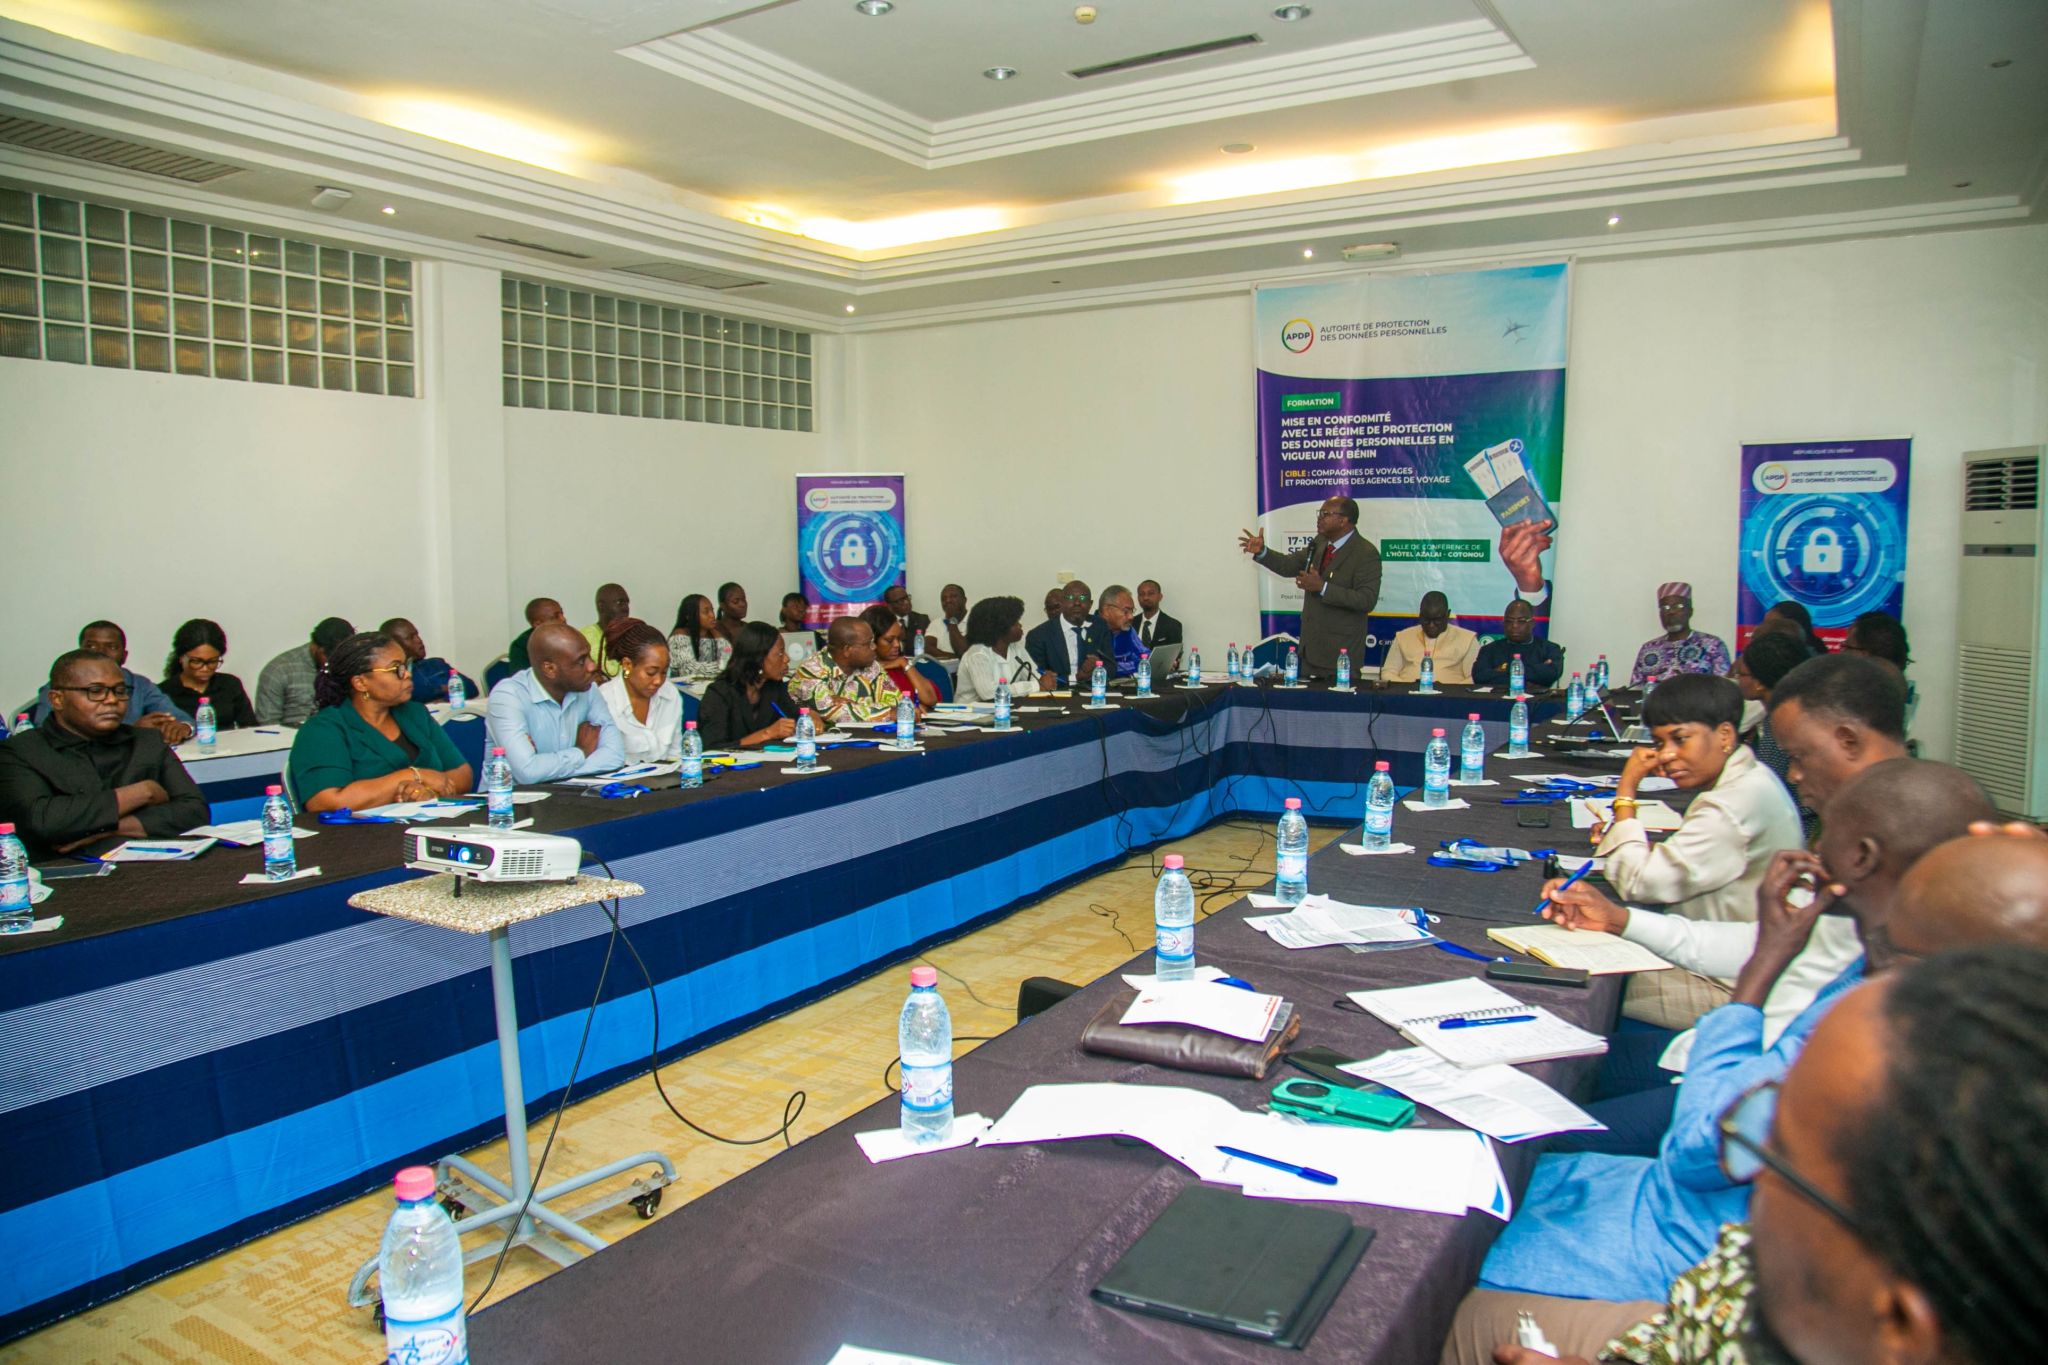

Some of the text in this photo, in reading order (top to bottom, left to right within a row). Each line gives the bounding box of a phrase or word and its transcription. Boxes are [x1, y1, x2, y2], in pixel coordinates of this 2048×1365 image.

[1320, 319, 1430, 334] AUTORITÉ DE PROTECTION
[1285, 332, 1311, 341] APDP
[1320, 326, 1447, 342] DES DONNÉES PERSONNELLES
[1286, 398, 1334, 407] FORMATION
[1281, 411, 1391, 427] MISE EN CONFORMITÉ
[1281, 423, 1453, 438] AVEC LE RÉGIME DE PROTECTION
[1281, 435, 1454, 449] DES DONNÉES PERSONNELLES EN
[1281, 448, 1377, 461] VIGUEUR AU BÉNIN
[1284, 469, 1306, 477] CIBLE
[1311, 468, 1363, 477] COMPAGNIES
[1375, 467, 1413, 475] VOYAGES
[1284, 475, 1451, 487] ET PROMOTEURS DES AGENCES DE VOYAGE
